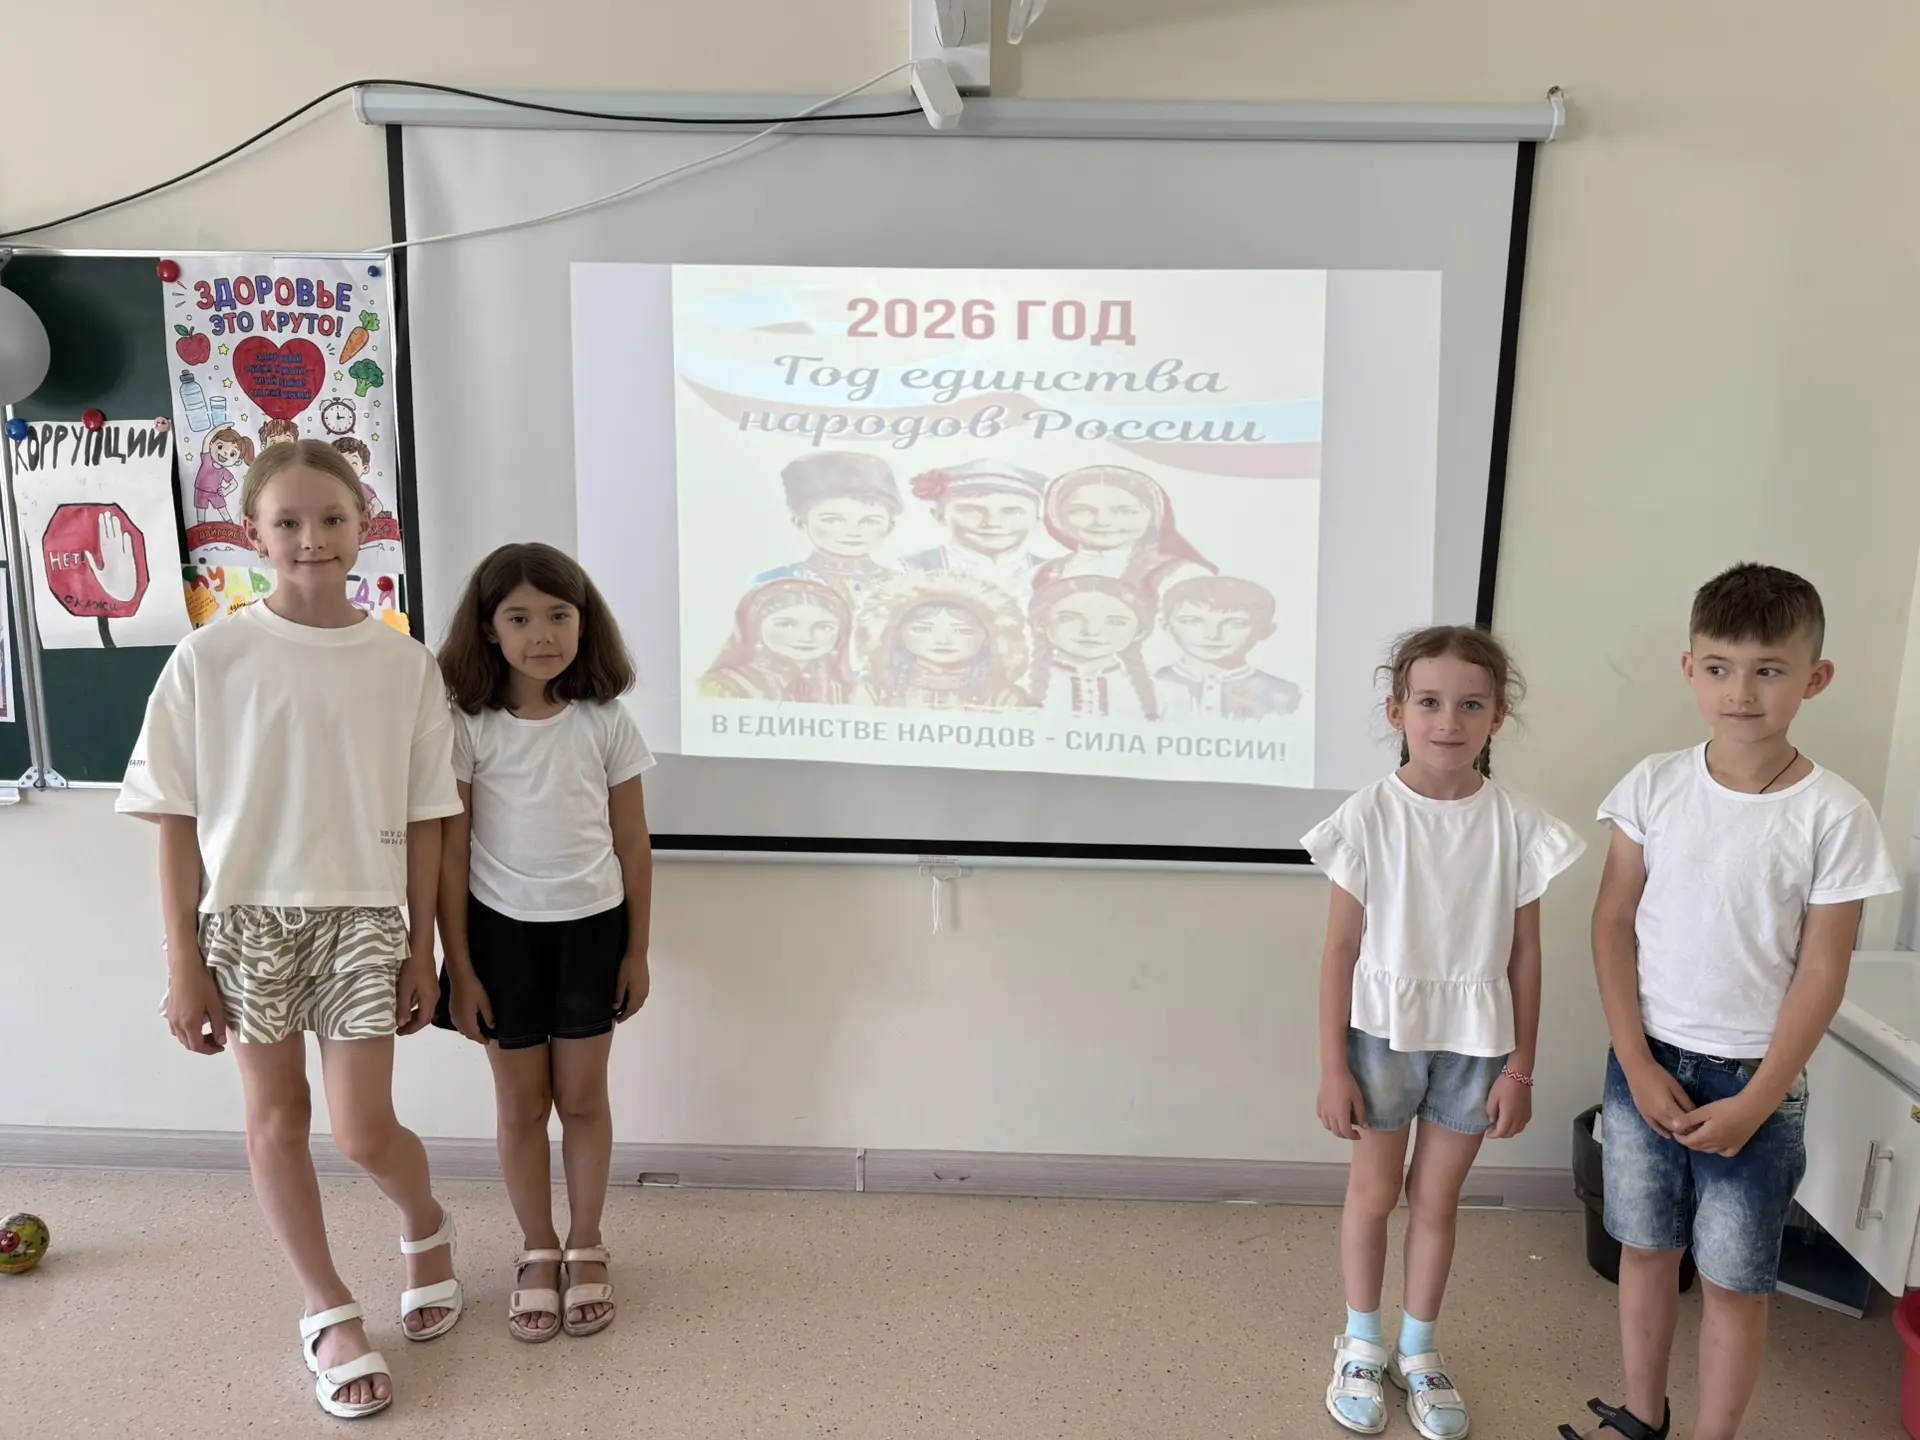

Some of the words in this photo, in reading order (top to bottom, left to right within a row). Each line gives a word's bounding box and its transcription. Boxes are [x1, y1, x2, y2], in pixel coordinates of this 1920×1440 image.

[194, 275, 352, 312] ЗДОРОВЬЕ
[209, 311, 254, 336] ЭТО
[260, 310, 344, 338] КРУТО!
[847, 297, 996, 340] 2026
[1016, 300, 1136, 346] ГОД
[773, 354, 881, 402] Год
[900, 358, 1228, 404] единства
[738, 404, 1009, 450] народов
[1021, 408, 1267, 443] России
[711, 714, 729, 734] В
[737, 715, 889, 741] ЕДИНСТВЕ
[898, 723, 1035, 748] НАРОДОВ
[1065, 730, 1147, 755] СИЛА
[1156, 736, 1286, 762] РОССИИ!
